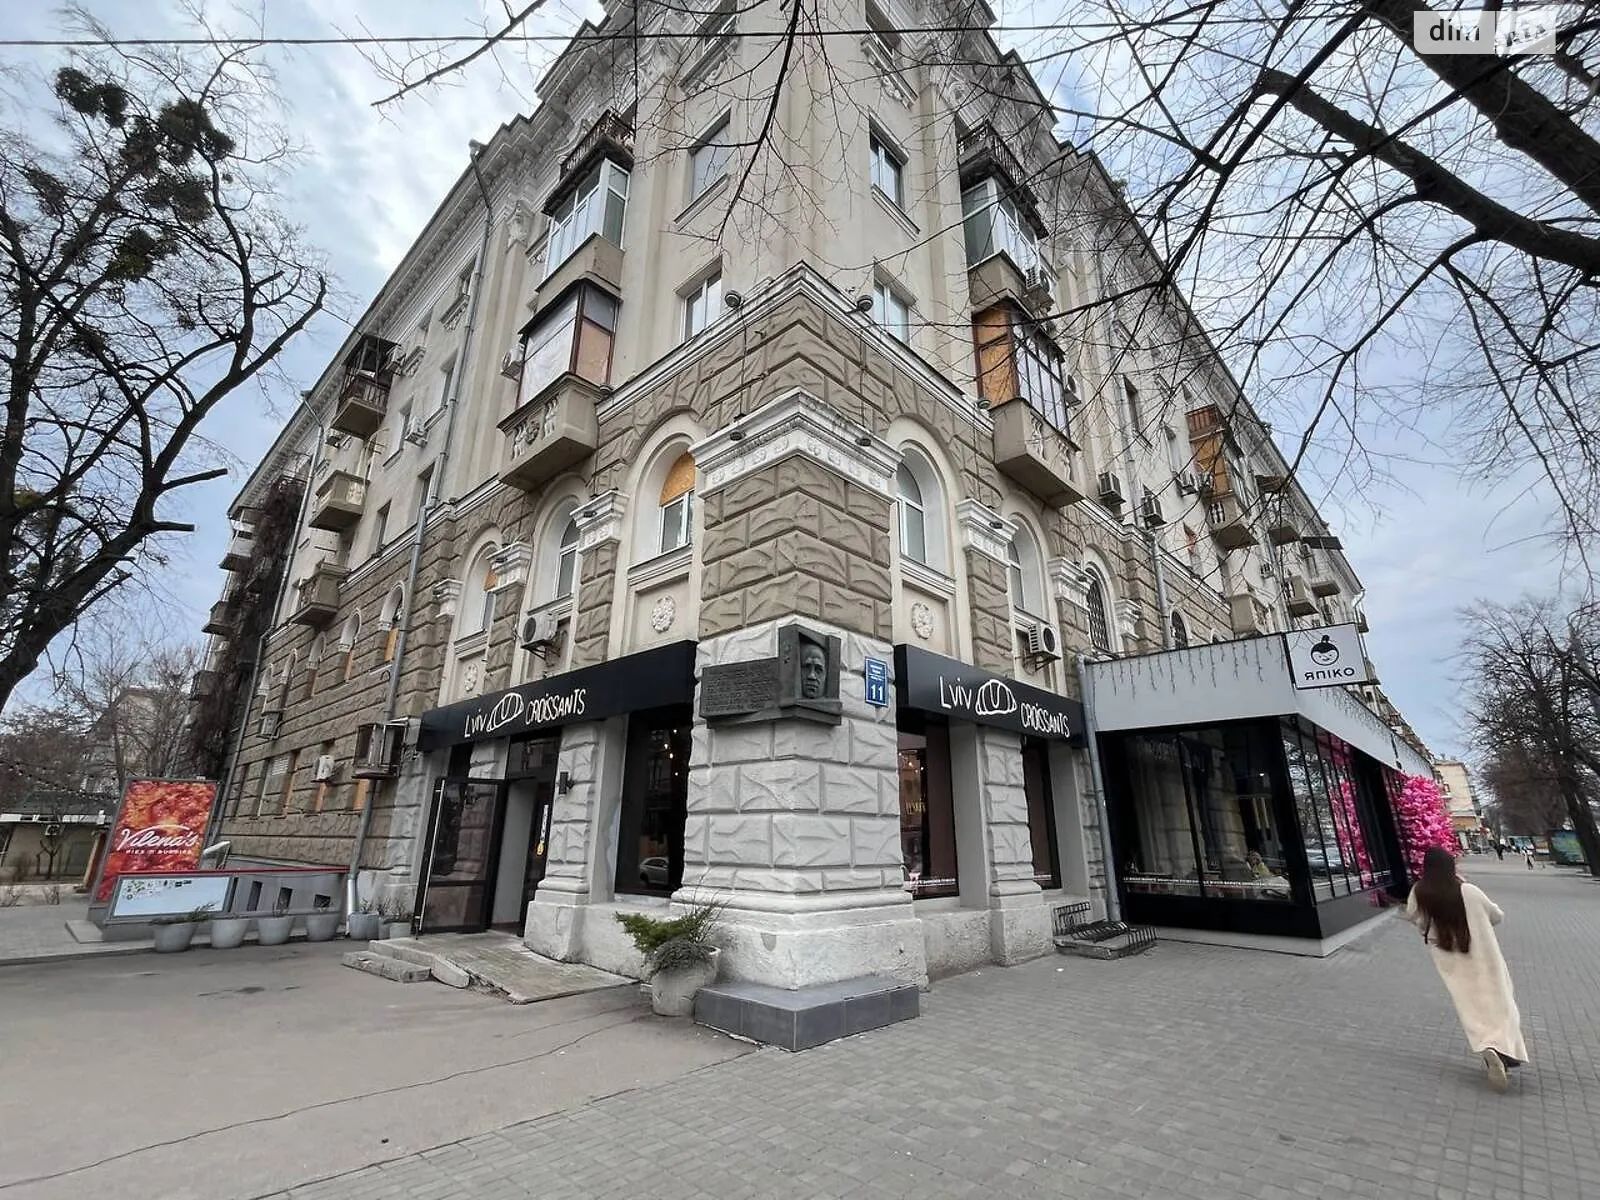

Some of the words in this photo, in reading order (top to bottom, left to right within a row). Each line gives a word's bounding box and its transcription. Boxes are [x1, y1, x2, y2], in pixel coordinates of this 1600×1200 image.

[464, 709, 488, 738] Lviv
[526, 689, 586, 725] CROISSANTS
[871, 684, 884, 701] 11
[940, 675, 972, 710] Lviv
[1020, 702, 1070, 738] CROISSANTS
